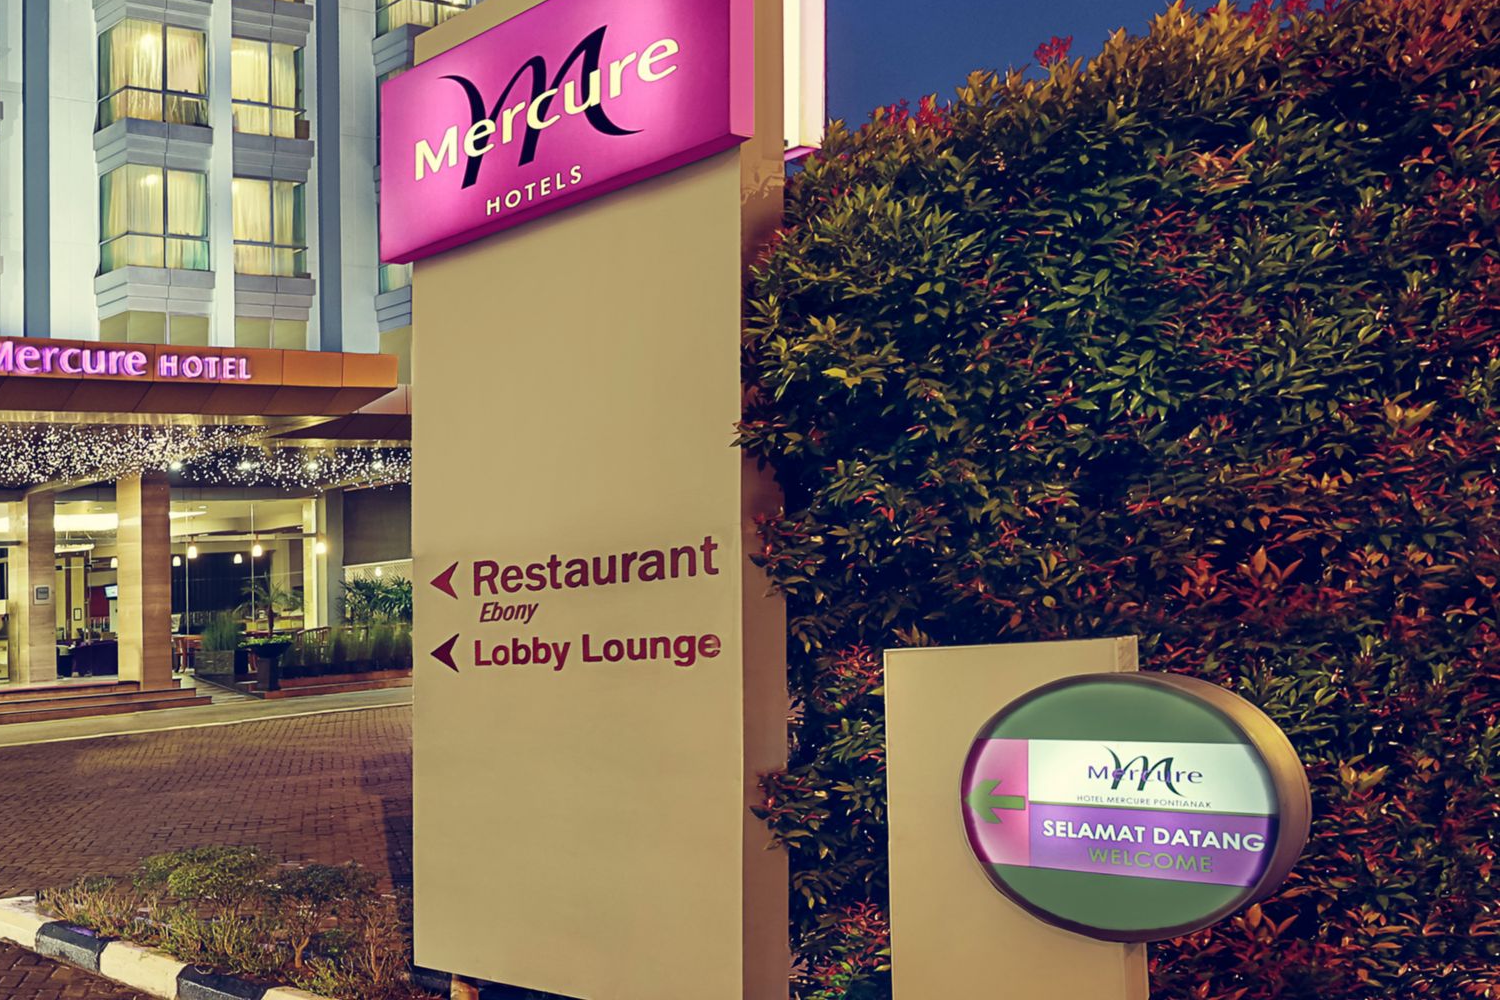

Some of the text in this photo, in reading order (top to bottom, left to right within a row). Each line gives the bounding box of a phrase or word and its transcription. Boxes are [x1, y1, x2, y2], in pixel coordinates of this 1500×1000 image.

[413, 36, 681, 182] Mercure
[485, 164, 584, 217] HOTELS
[158, 354, 252, 380] HOTEL
[472, 535, 720, 597] Restaurant
[479, 601, 539, 625] Ebony
[474, 633, 722, 672] Lobby Lounge
[1087, 764, 1204, 784] Mercure
[1077, 794, 1213, 809] HOTEL MERCURE PONTIANAK
[1042, 819, 1266, 852] SELAMAT DATANG
[1088, 846, 1213, 873] WELCOME
